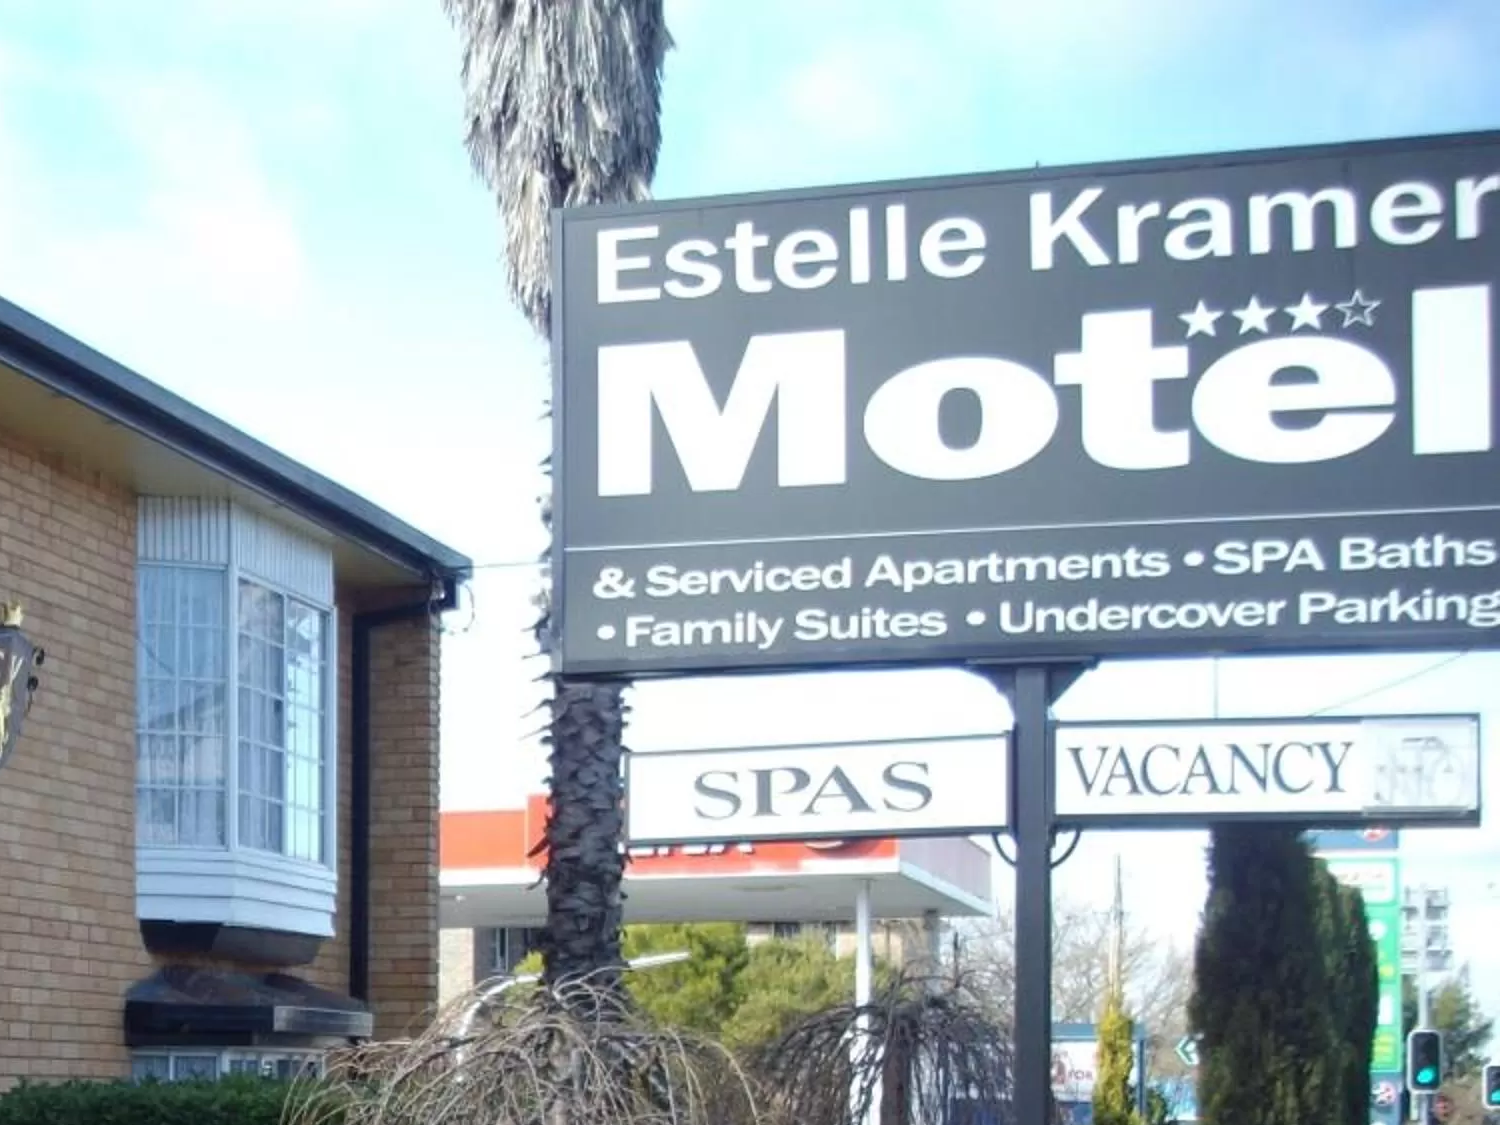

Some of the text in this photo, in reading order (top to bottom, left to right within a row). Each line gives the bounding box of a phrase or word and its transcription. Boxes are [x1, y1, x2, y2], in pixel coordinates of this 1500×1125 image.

[595, 175, 1500, 305] Estelle Kramer
[596, 283, 1492, 497] Motel
[592, 533, 1498, 600] & Serviced Apartments SPA Baths
[625, 588, 1500, 651] Family Suites Undercover Parking
[692, 759, 934, 822] SPAS
[1067, 740, 1353, 797] VACANCY
